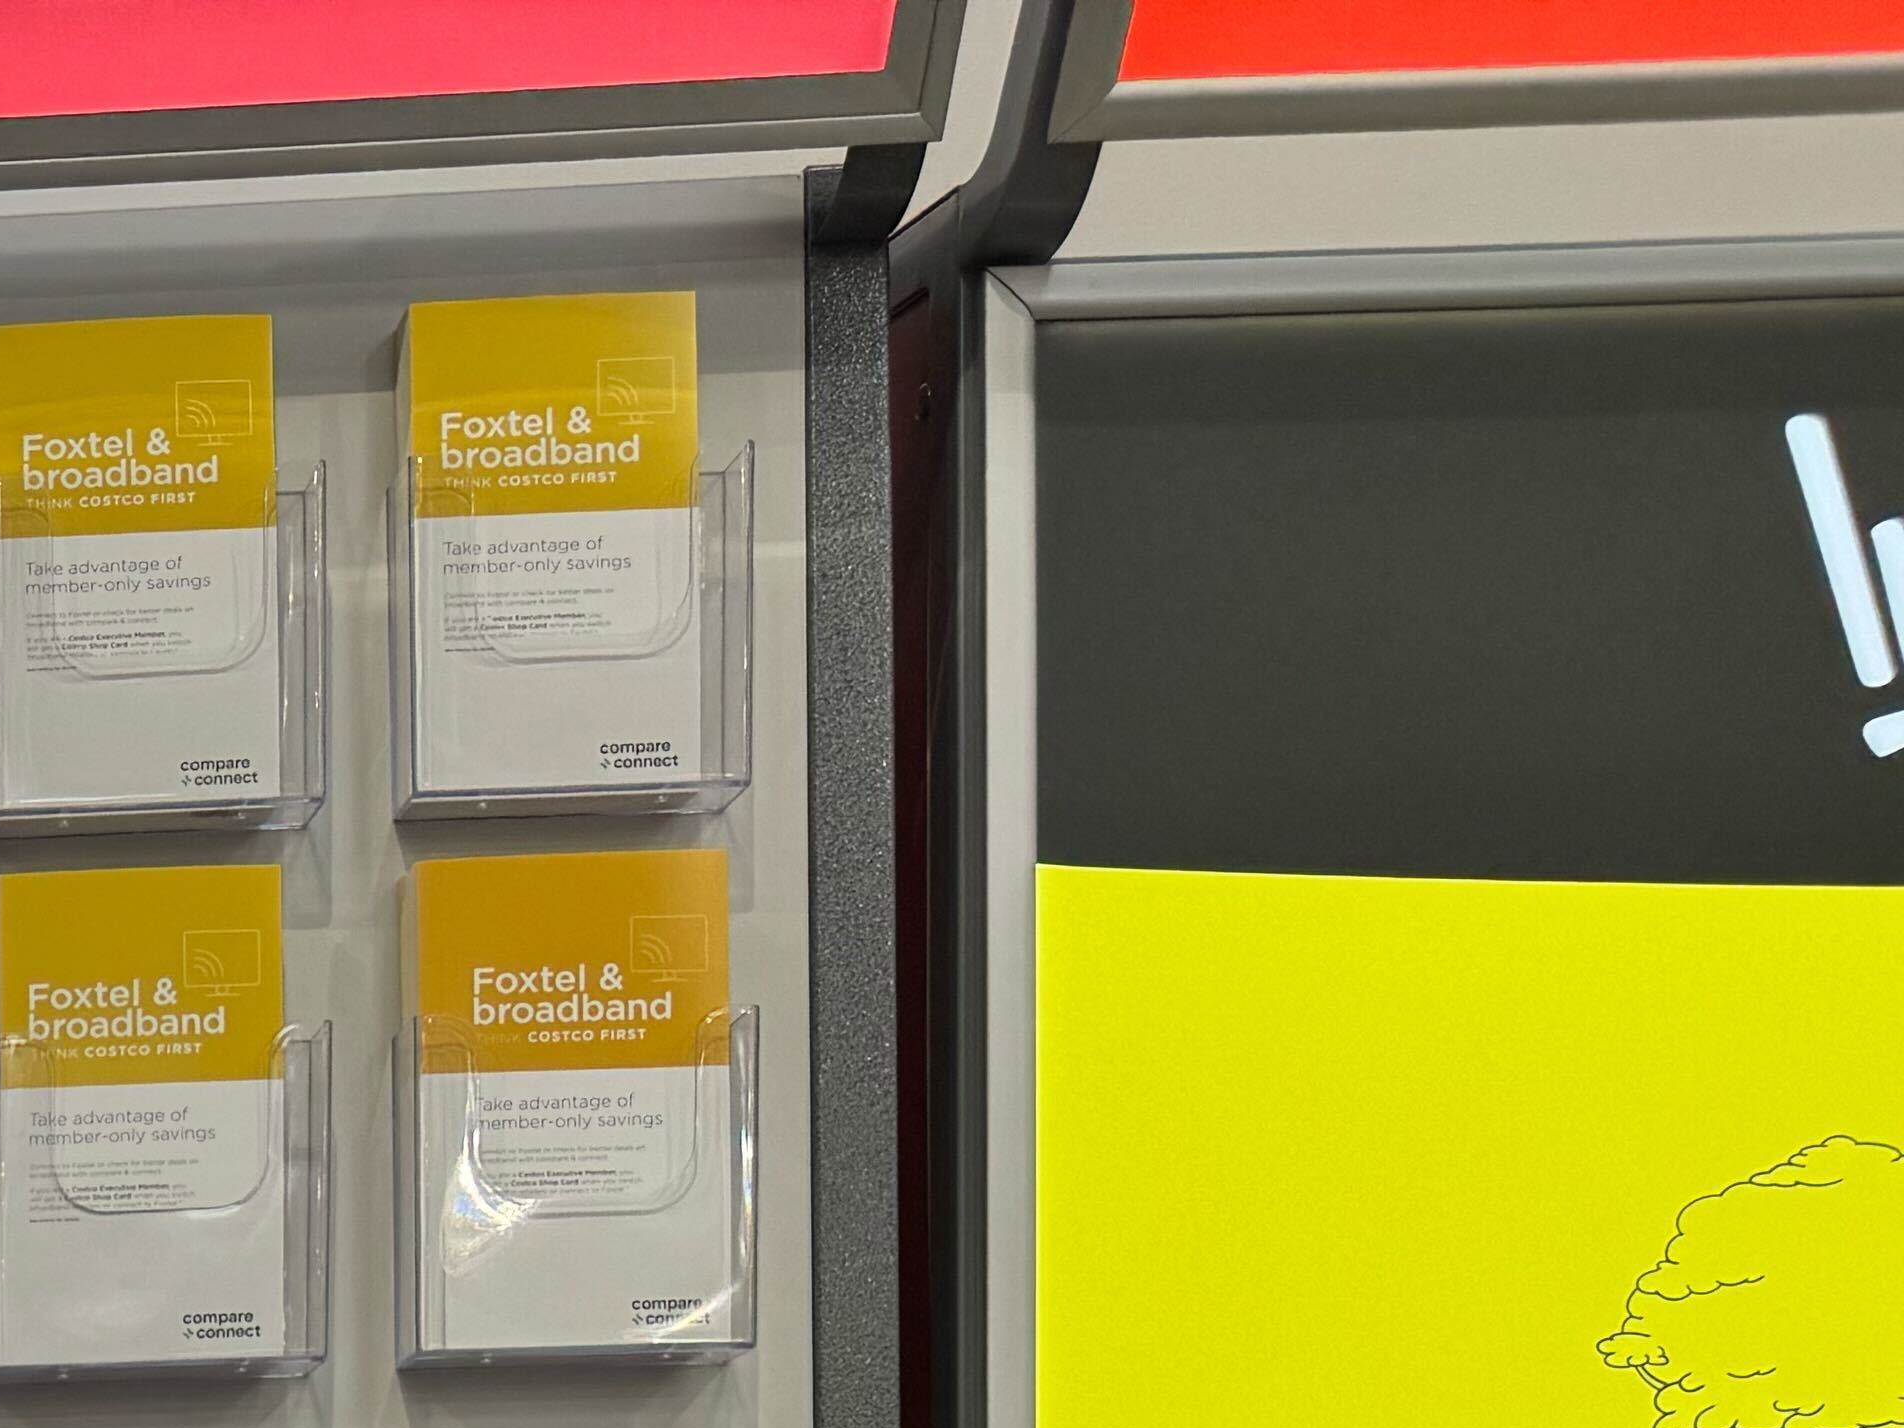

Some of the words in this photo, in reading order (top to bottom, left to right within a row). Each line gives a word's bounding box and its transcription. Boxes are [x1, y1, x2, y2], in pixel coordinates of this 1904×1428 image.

[22, 428, 135, 461] Foxtel
[146, 428, 171, 455] &
[24, 455, 219, 491] broadband
[80, 494, 145, 508] COSTCO
[152, 491, 195, 504] FIRST
[26, 561, 62, 576] Take
[69, 559, 158, 578] advantage
[166, 556, 182, 570] of
[26, 574, 142, 595] member-only
[147, 574, 211, 591] savings
